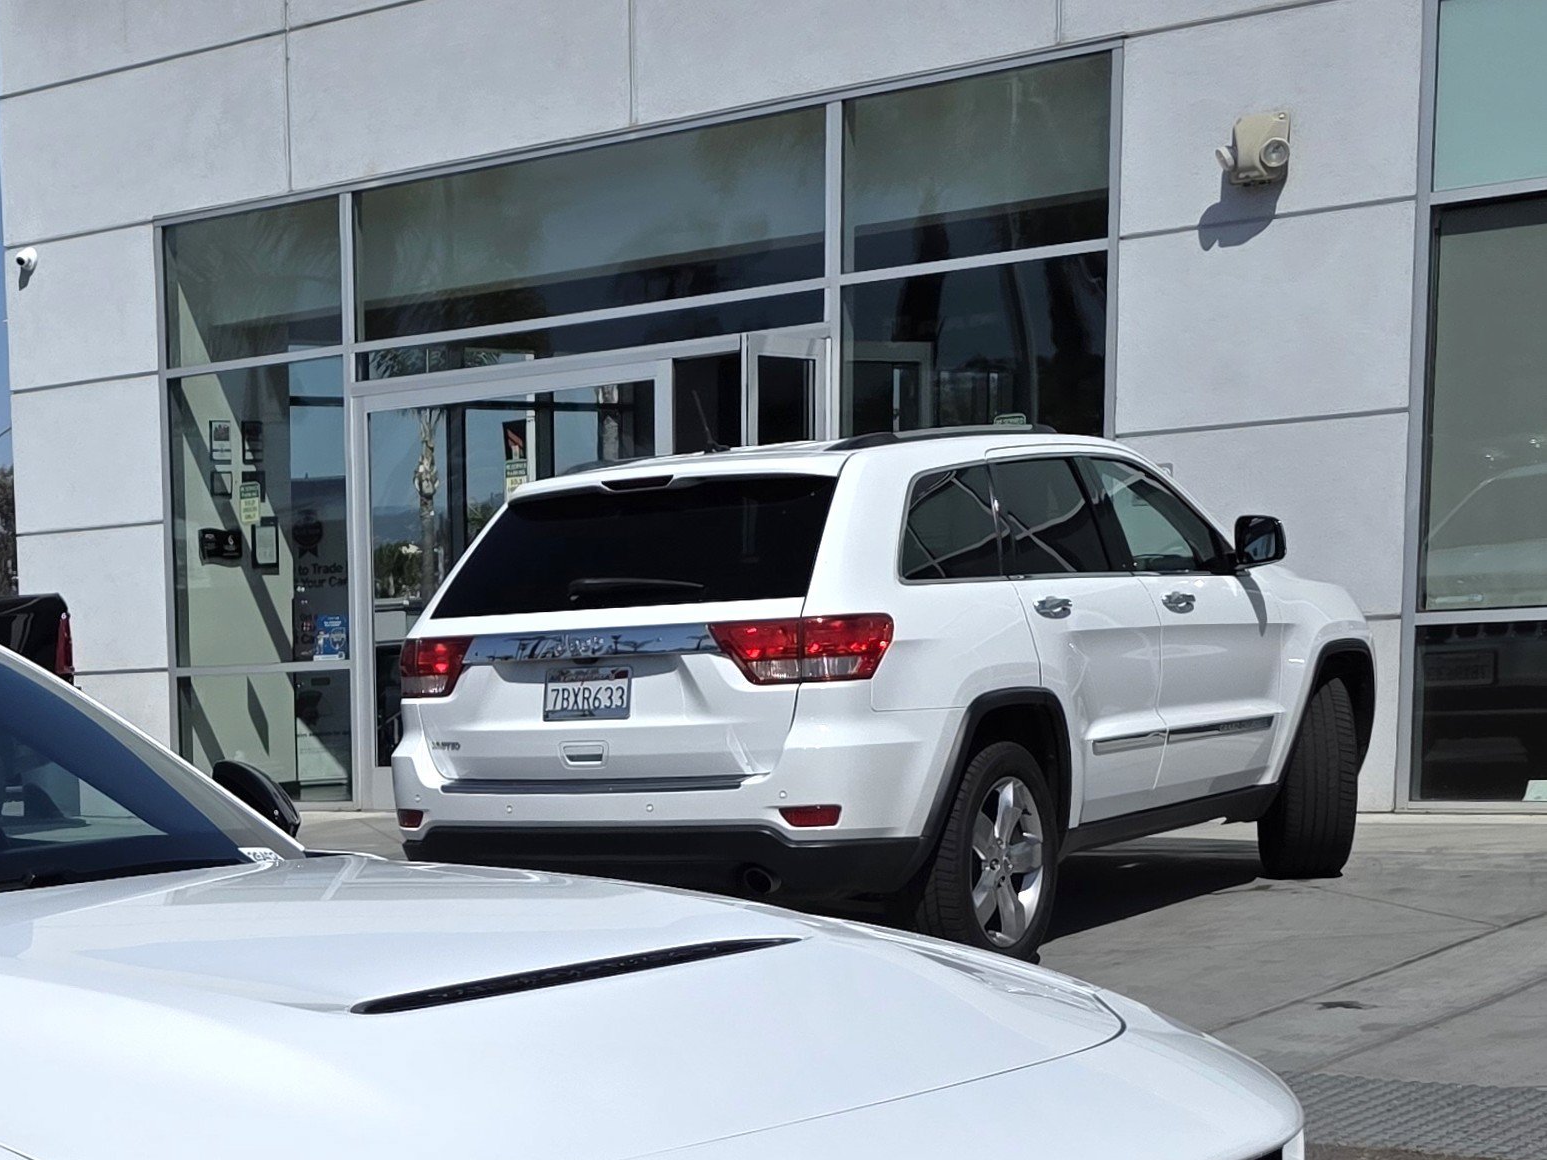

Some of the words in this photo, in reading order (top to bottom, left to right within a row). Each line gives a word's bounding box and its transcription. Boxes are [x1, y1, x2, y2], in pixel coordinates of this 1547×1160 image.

[311, 562, 344, 575] Trade
[302, 576, 327, 589] Your
[550, 686, 625, 711] 7BXR633
